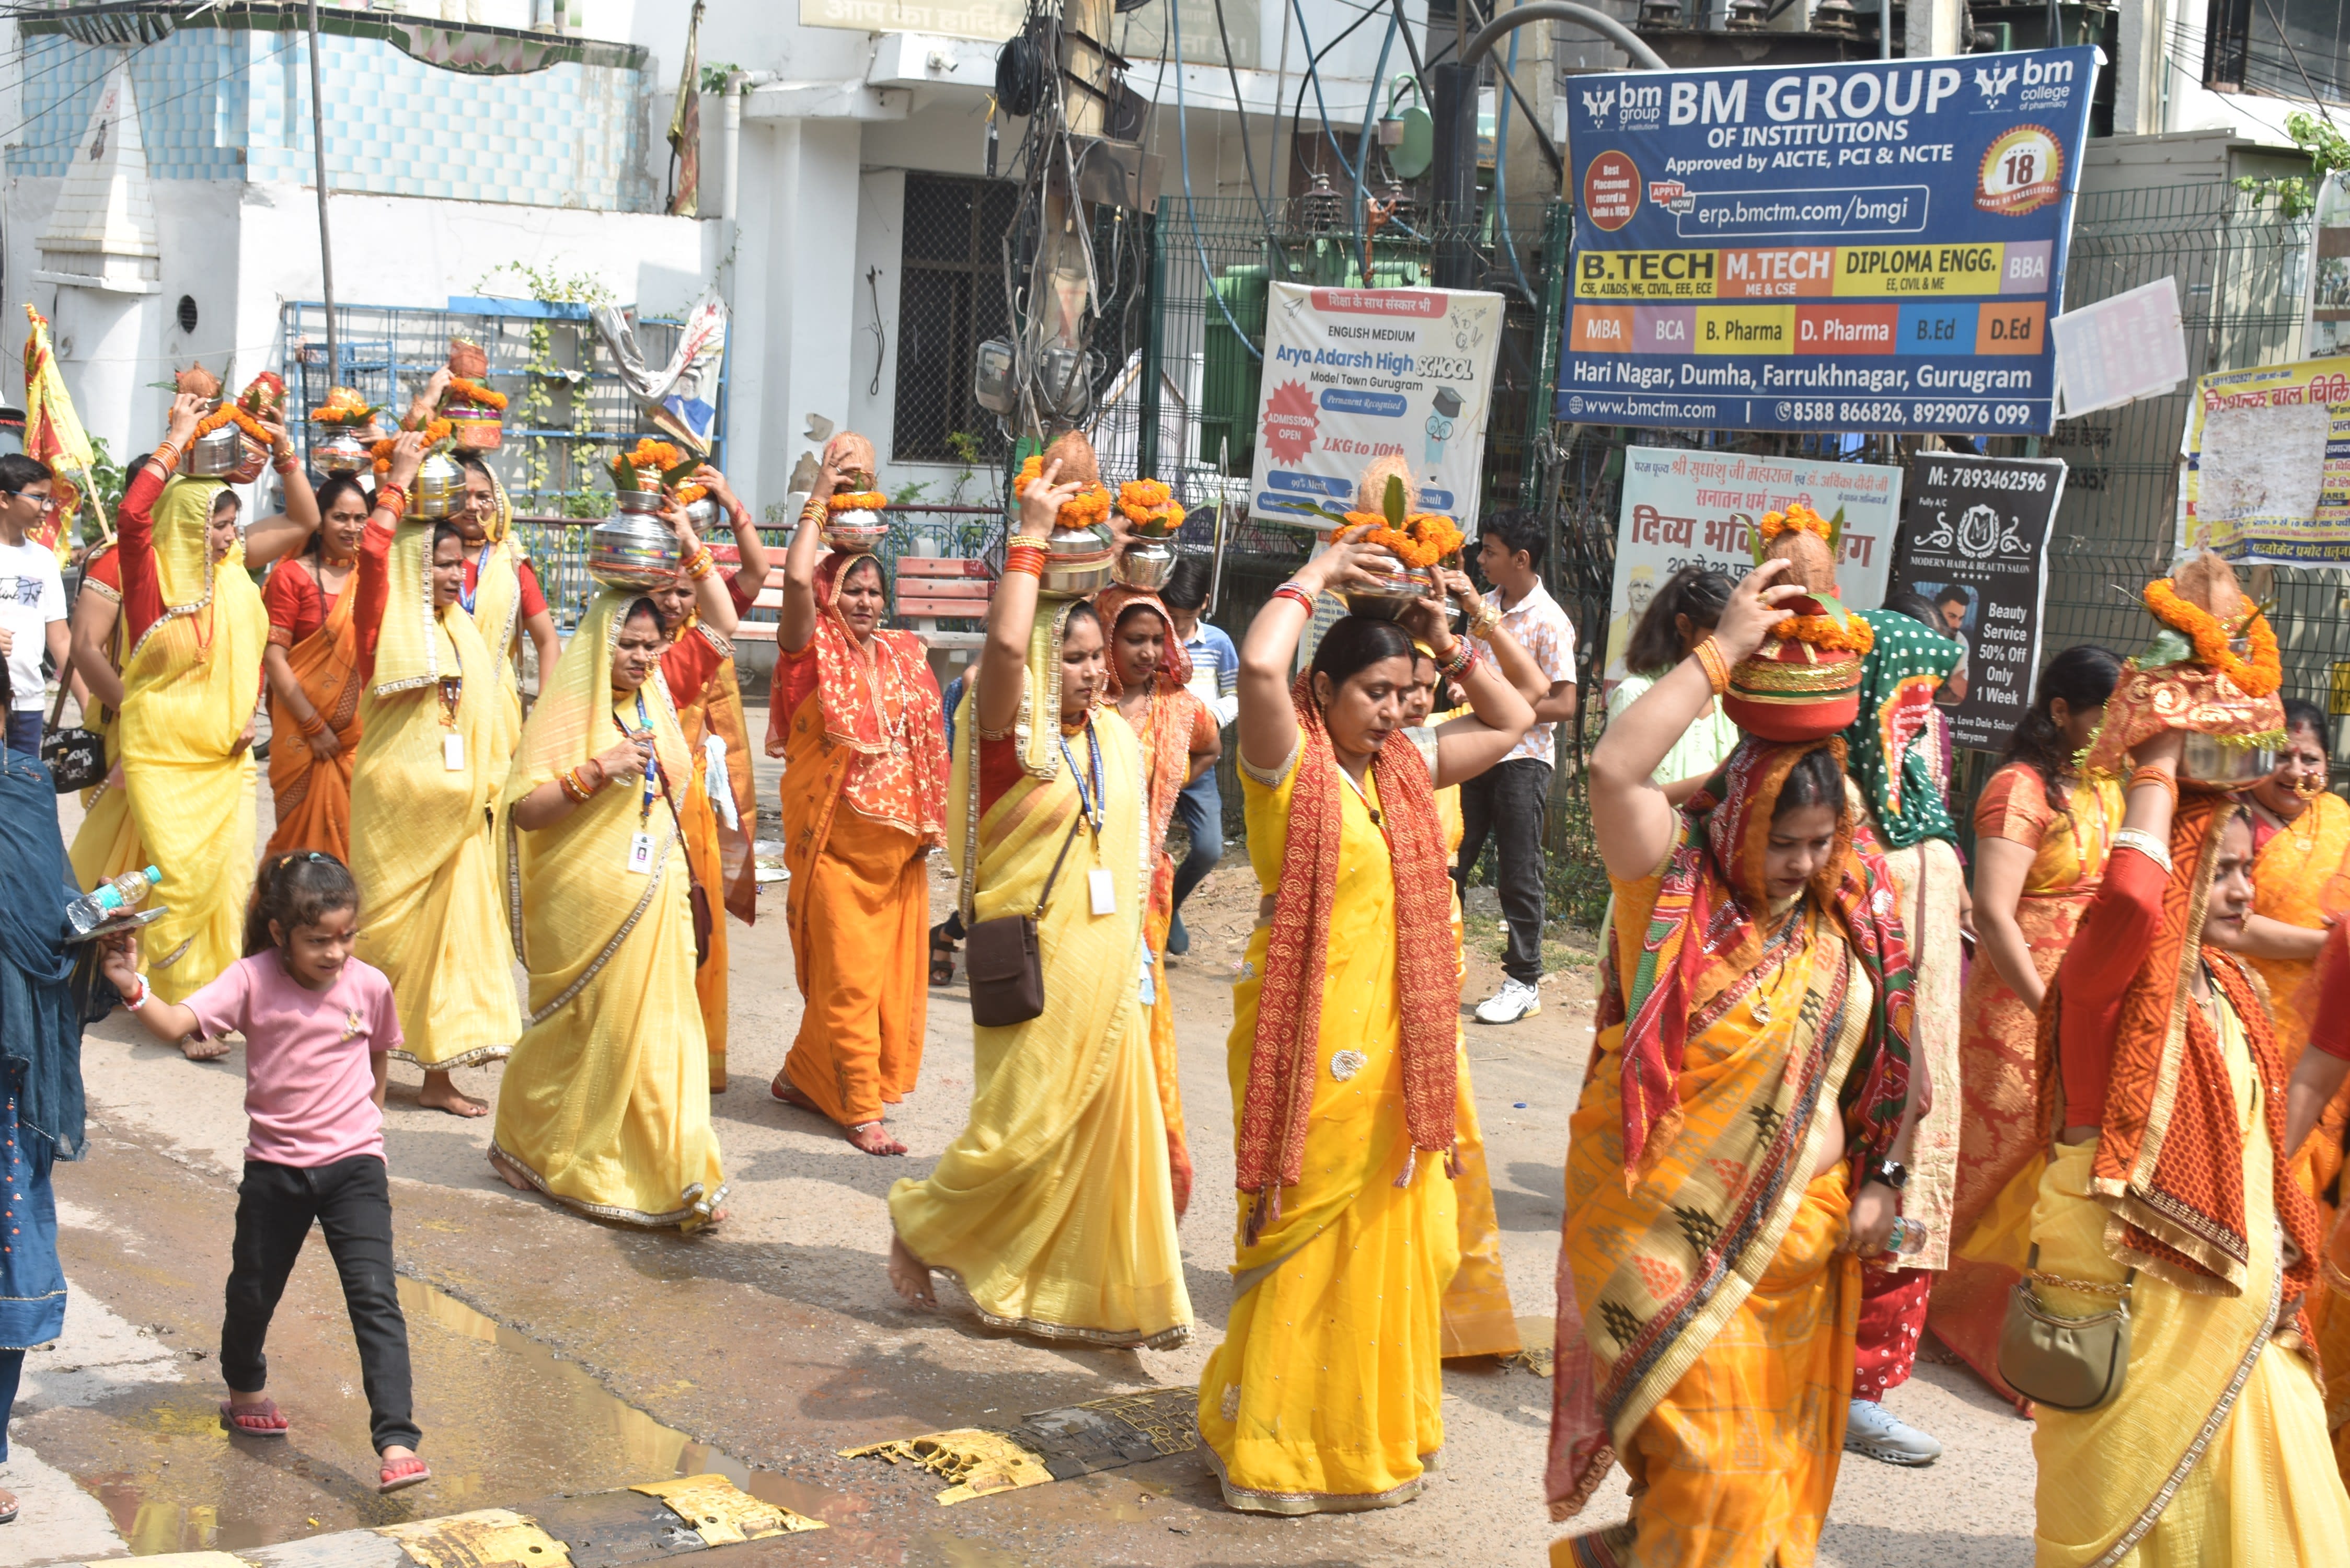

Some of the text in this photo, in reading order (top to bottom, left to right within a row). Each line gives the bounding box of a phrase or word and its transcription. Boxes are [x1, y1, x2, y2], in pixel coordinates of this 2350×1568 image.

[2022, 57, 2074, 85] bm
[1619, 81, 1662, 109] bm
[1668, 67, 1961, 125] BM GROUP
[2021, 85, 2070, 101] college
[1619, 106, 1661, 123] group
[2019, 100, 2068, 112] of pharmacy
[1627, 123, 1660, 131] institutions
[1708, 119, 1909, 148] OF INSTITUTIONS
[1603, 165, 1620, 176] Best
[1665, 144, 1954, 176] Approved by AICTE, PCI & NCTE
[2005, 154, 2034, 186] 18
[1593, 179, 1630, 190] Placement
[1652, 186, 1681, 197] APPLY
[1595, 192, 1627, 203] record in
[1671, 199, 1692, 208] NOW
[2002, 195, 2011, 204] OF
[1592, 206, 1630, 218] Delhi & NCR
[1699, 194, 1909, 228] erp.bmctm.com/bmgi
[1583, 252, 1714, 280] B.TECH
[1726, 250, 1831, 281] M.TECH
[1846, 248, 1997, 274] DIPLOMA ENGG.
[2009, 256, 2045, 279] BBA
[1581, 282, 1712, 296] CSE, AI&DS, ME, CIVIL, EEE, ECE
[1745, 282, 1798, 296] ME & CSE
[1886, 276, 1945, 292] EE, CIVIL & ME
[1328, 292, 1431, 313] शिक्षा के साथ संस्कार भी
[1328, 325, 1415, 342] ENGLISH MEDIUM
[1586, 318, 1621, 340] MBA
[1655, 319, 1685, 340] BCA
[1706, 319, 1782, 341] B. Pharma
[1800, 318, 1890, 341] D. Pharma
[1916, 317, 1956, 341] B.Ed
[1990, 316, 2032, 340] D.Ed
[1275, 344, 1474, 381] Arya Adarsh High SCHOOL
[1310, 371, 1423, 393] Model Town Gurugram
[1573, 360, 2032, 394] Hari Nagar, Dumha, Farrukhnagar, Gurugram
[1327, 395, 1403, 412] Permanent Recognised
[1585, 396, 1717, 419] www.bmctm.com
[1793, 401, 2031, 426] 8588 866826, 8929076 099
[1268, 412, 1315, 428] ADMISSION
[1278, 428, 1301, 441] OPEN
[1322, 436, 1404, 456] LKG to 10th
[1291, 477, 1306, 488] 99%
[1634, 454, 1889, 492] परम पूज्य श्री सुधांशु जी महाराज एवं डॉ. अर्चिका दीदी जी
[1927, 465, 2048, 492] M: 7893462596
[1697, 489, 1743, 510] सनातन
[1745, 488, 1768, 512] धर्म
[1919, 497, 1948, 508] Fully A/C
[1631, 504, 1697, 549] दिव्य
[1666, 557, 1688, 574] 20
[1909, 556, 2030, 574] MODERN HAIR & BEAUTY SALON
[1988, 602, 2028, 624] Beauty
[1983, 622, 2028, 641] Service
[1978, 643, 2028, 663] 50% Off
[1987, 666, 2014, 687] Only
[1976, 686, 2019, 706] 1 Week
[1957, 714, 1975, 727] Love
[1975, 717, 1992, 729] Dale
[1956, 729, 1988, 743] Haryana
